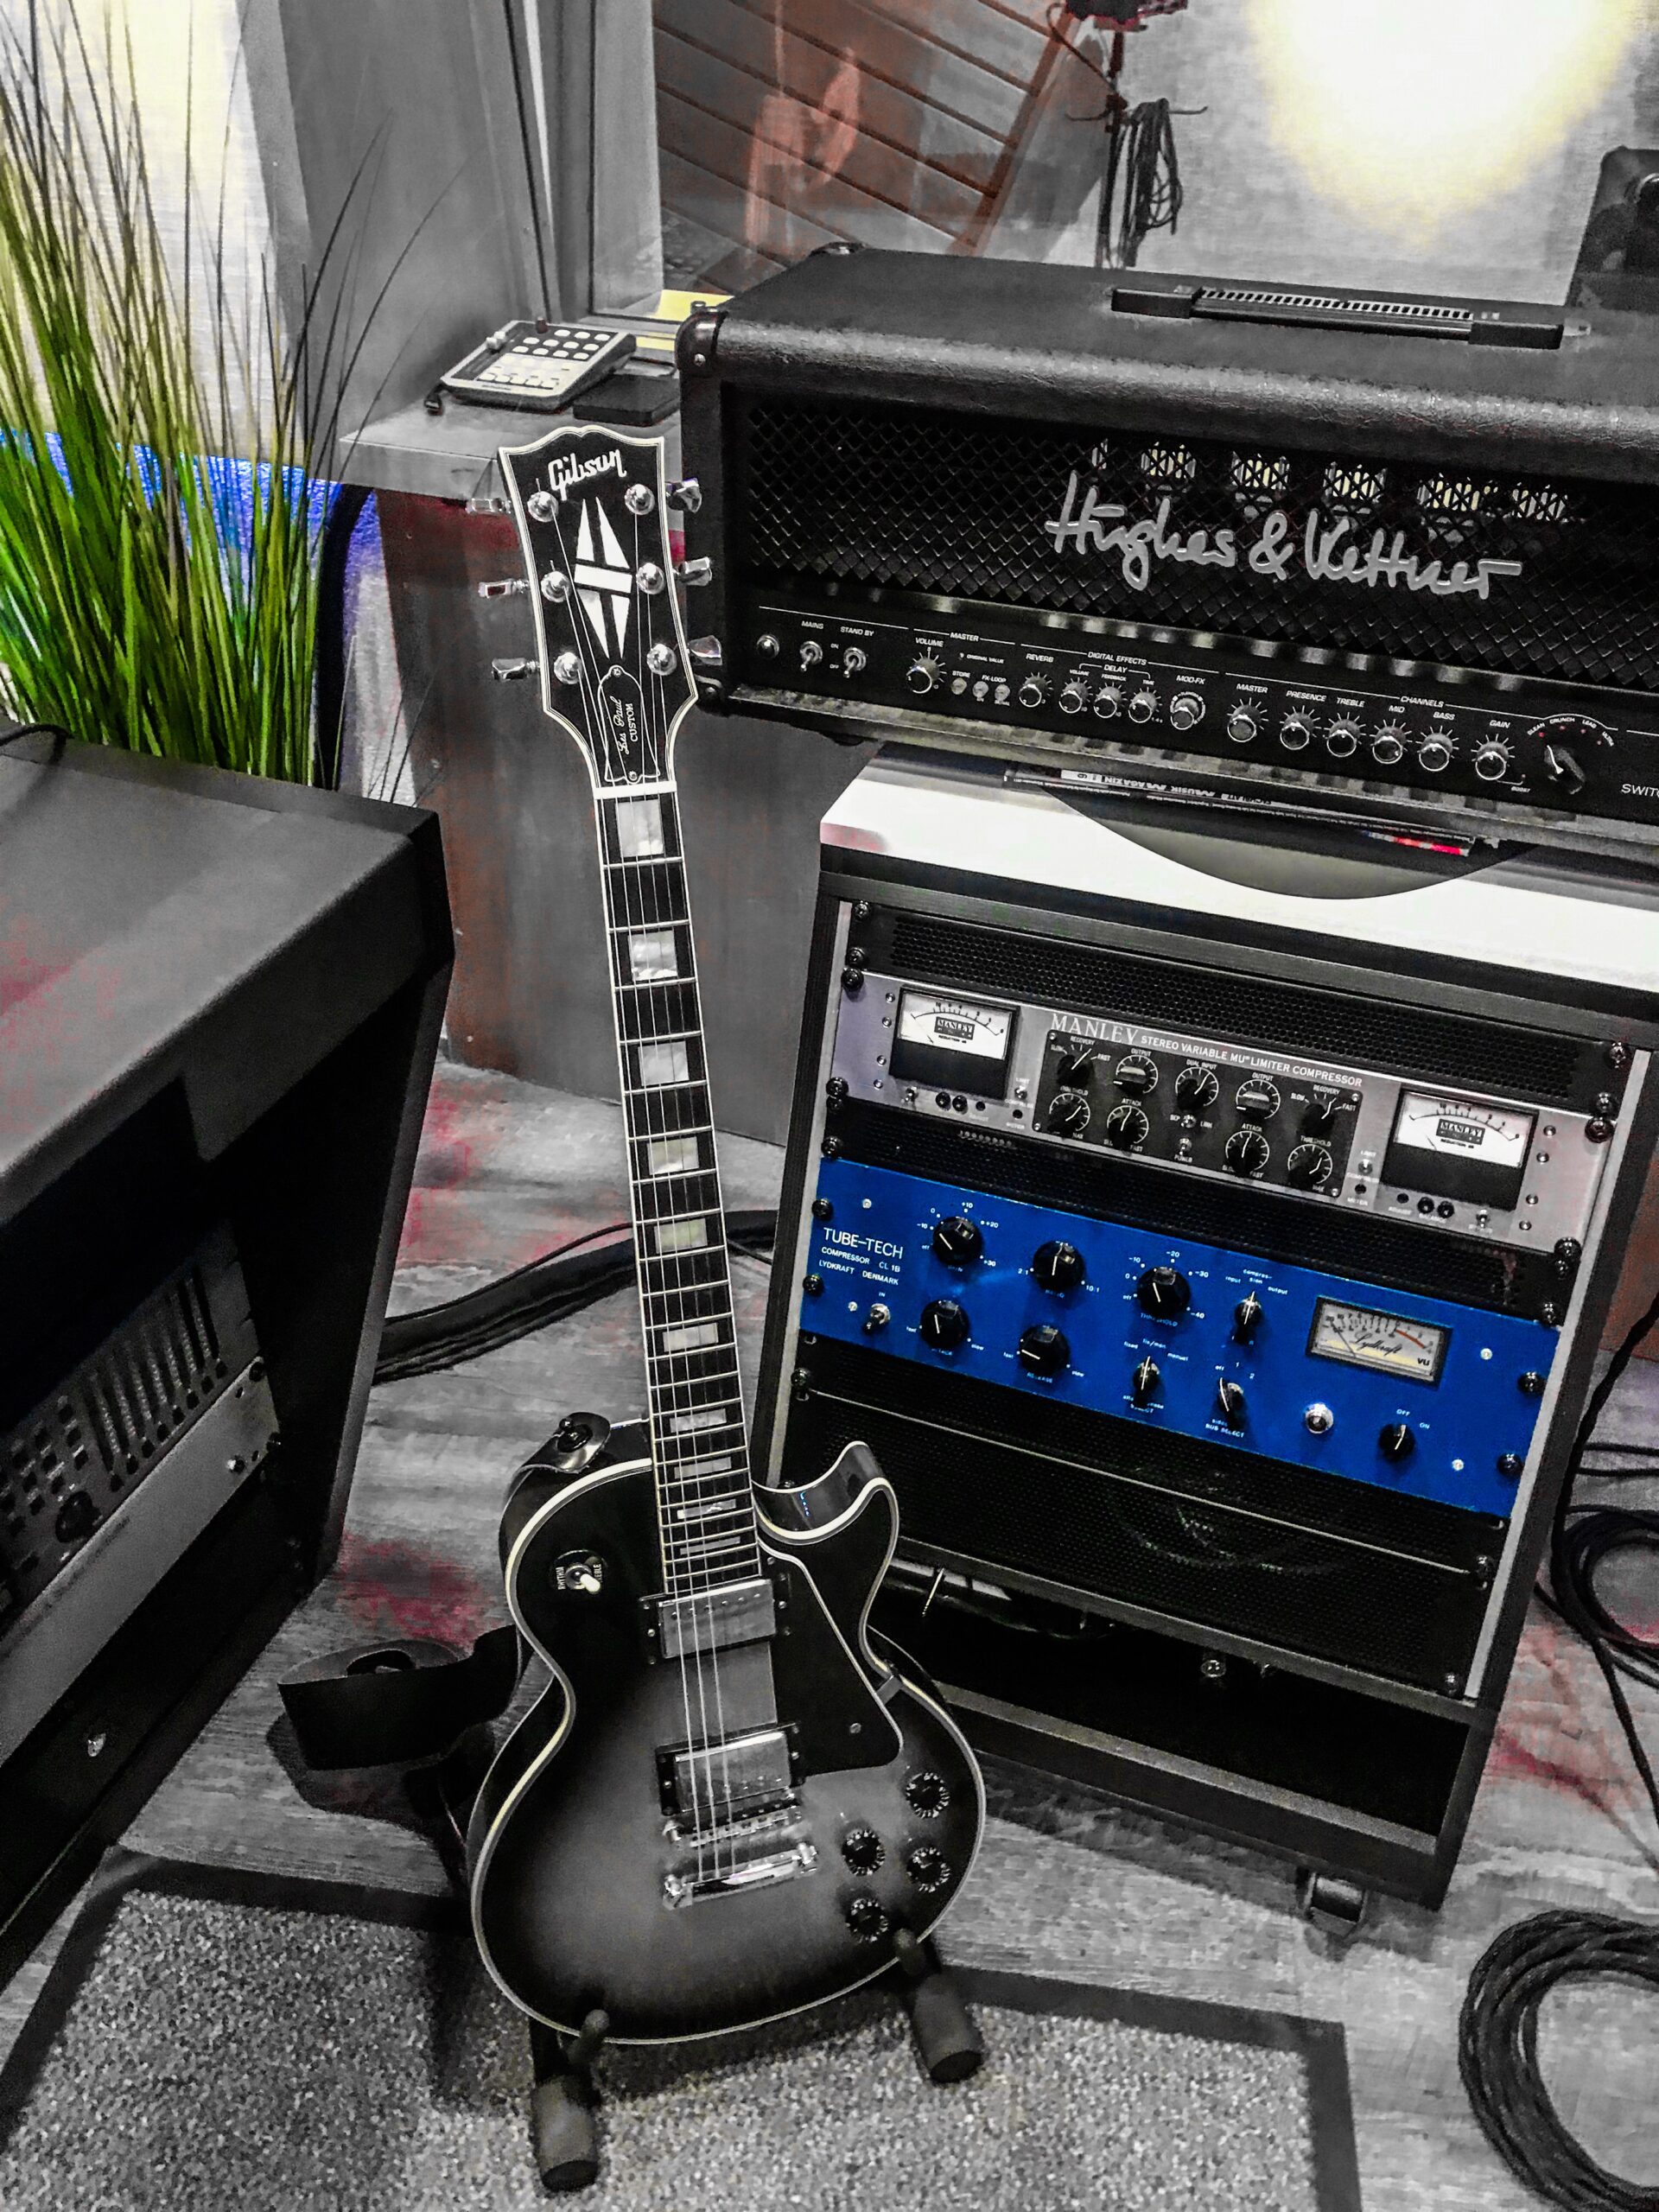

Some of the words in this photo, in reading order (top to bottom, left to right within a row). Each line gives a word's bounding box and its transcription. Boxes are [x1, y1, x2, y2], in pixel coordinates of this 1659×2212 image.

[548, 449, 627, 501] Gibson
[1045, 470, 1236, 590] Hughes
[1249, 511, 1294, 580] &
[1305, 510, 1522, 598] Kettner
[801, 620, 824, 630] MAINS
[841, 626, 863, 635] STAND
[915, 637, 944, 647] VOLUME
[950, 632, 979, 642] MASTER
[1026, 652, 1054, 663] REVERB
[1087, 651, 1115, 662] DIGITAL
[1116, 655, 1147, 666] EFFECTS
[1103, 664, 1128, 673] DELAY
[952, 670, 971, 678] STORE
[982, 674, 1007, 683] FX-LOOP
[1176, 675, 1206, 685] MOD-FX
[1236, 683, 1268, 694] MASTER
[1286, 690, 1327, 702] PRESENCE
[1336, 696, 1365, 708] TREBLE
[1400, 696, 1445, 709] CHANNELS
[609, 695, 626, 728] Paul
[1389, 704, 1405, 714] MID
[1433, 711, 1456, 721] BASS
[625, 702, 639, 742] CUSTOM
[1489, 719, 1511, 729] GAIN
[937, 1019, 973, 1033] MANLEY
[1070, 1036, 1096, 1046] RECOVERY
[1051, 1013, 1139, 1046] MANLEY
[1141, 1035, 1179, 1051] STEREO
[1181, 1042, 1228, 1060] VARIABLE
[1250, 1056, 1290, 1073] LIMITER
[1292, 1065, 1363, 1088] COMPRESSOR
[1130, 1047, 1152, 1057] OUTPUT
[1096, 1052, 1111, 1062] FAST
[1251, 1071, 1274, 1082] OUTPUT
[1313, 1084, 1341, 1096] RECOVERY
[1122, 1097, 1142, 1107] ATTACK
[1342, 1103, 1357, 1112] FAST
[1241, 1122, 1262, 1132] ATTACK
[823, 1227, 904, 1260] TUBE-TECH
[821, 1246, 870, 1265] COMPRESSOR
[879, 1262, 889, 1270] CL
[891, 1264, 901, 1273] 1B
[818, 1259, 855, 1274] LYDKRAFT
[861, 1270, 899, 1286] DENMARK
[1416, 1357, 1431, 1366] VU
[1395, 1408, 1411, 1417] OFF
[1419, 1421, 1431, 1430] ON
